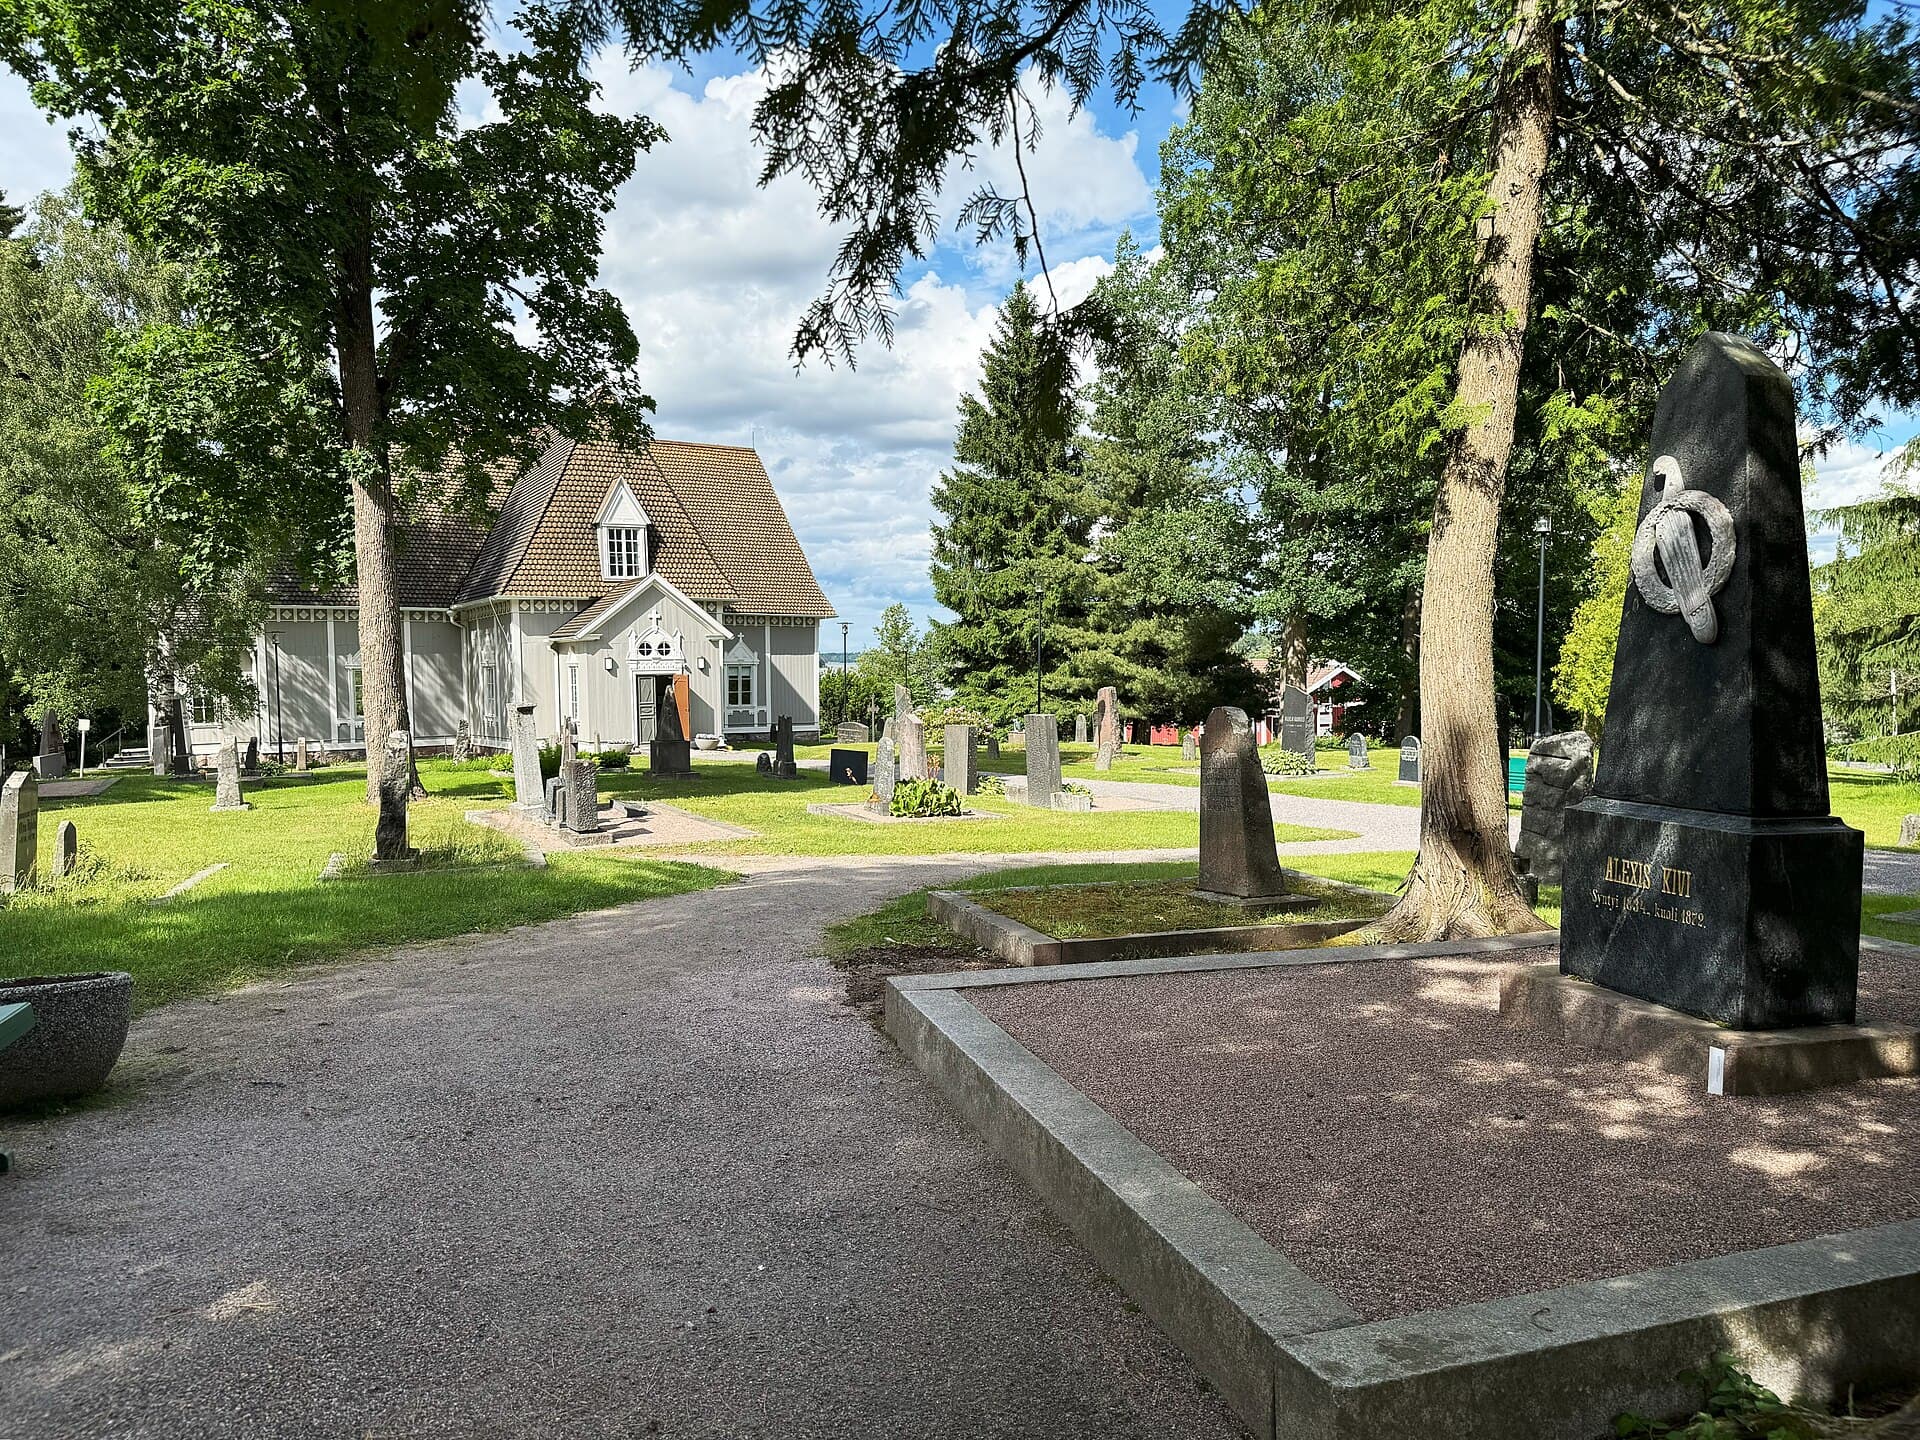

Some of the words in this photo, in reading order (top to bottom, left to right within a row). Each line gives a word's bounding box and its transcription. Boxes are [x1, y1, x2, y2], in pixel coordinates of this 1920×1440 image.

[1605, 856, 1651, 890] ALEXIS
[1661, 867, 1692, 898] KIVI
[1591, 888, 1619, 911] Syntyi
[1654, 902, 1678, 922] kuoli
